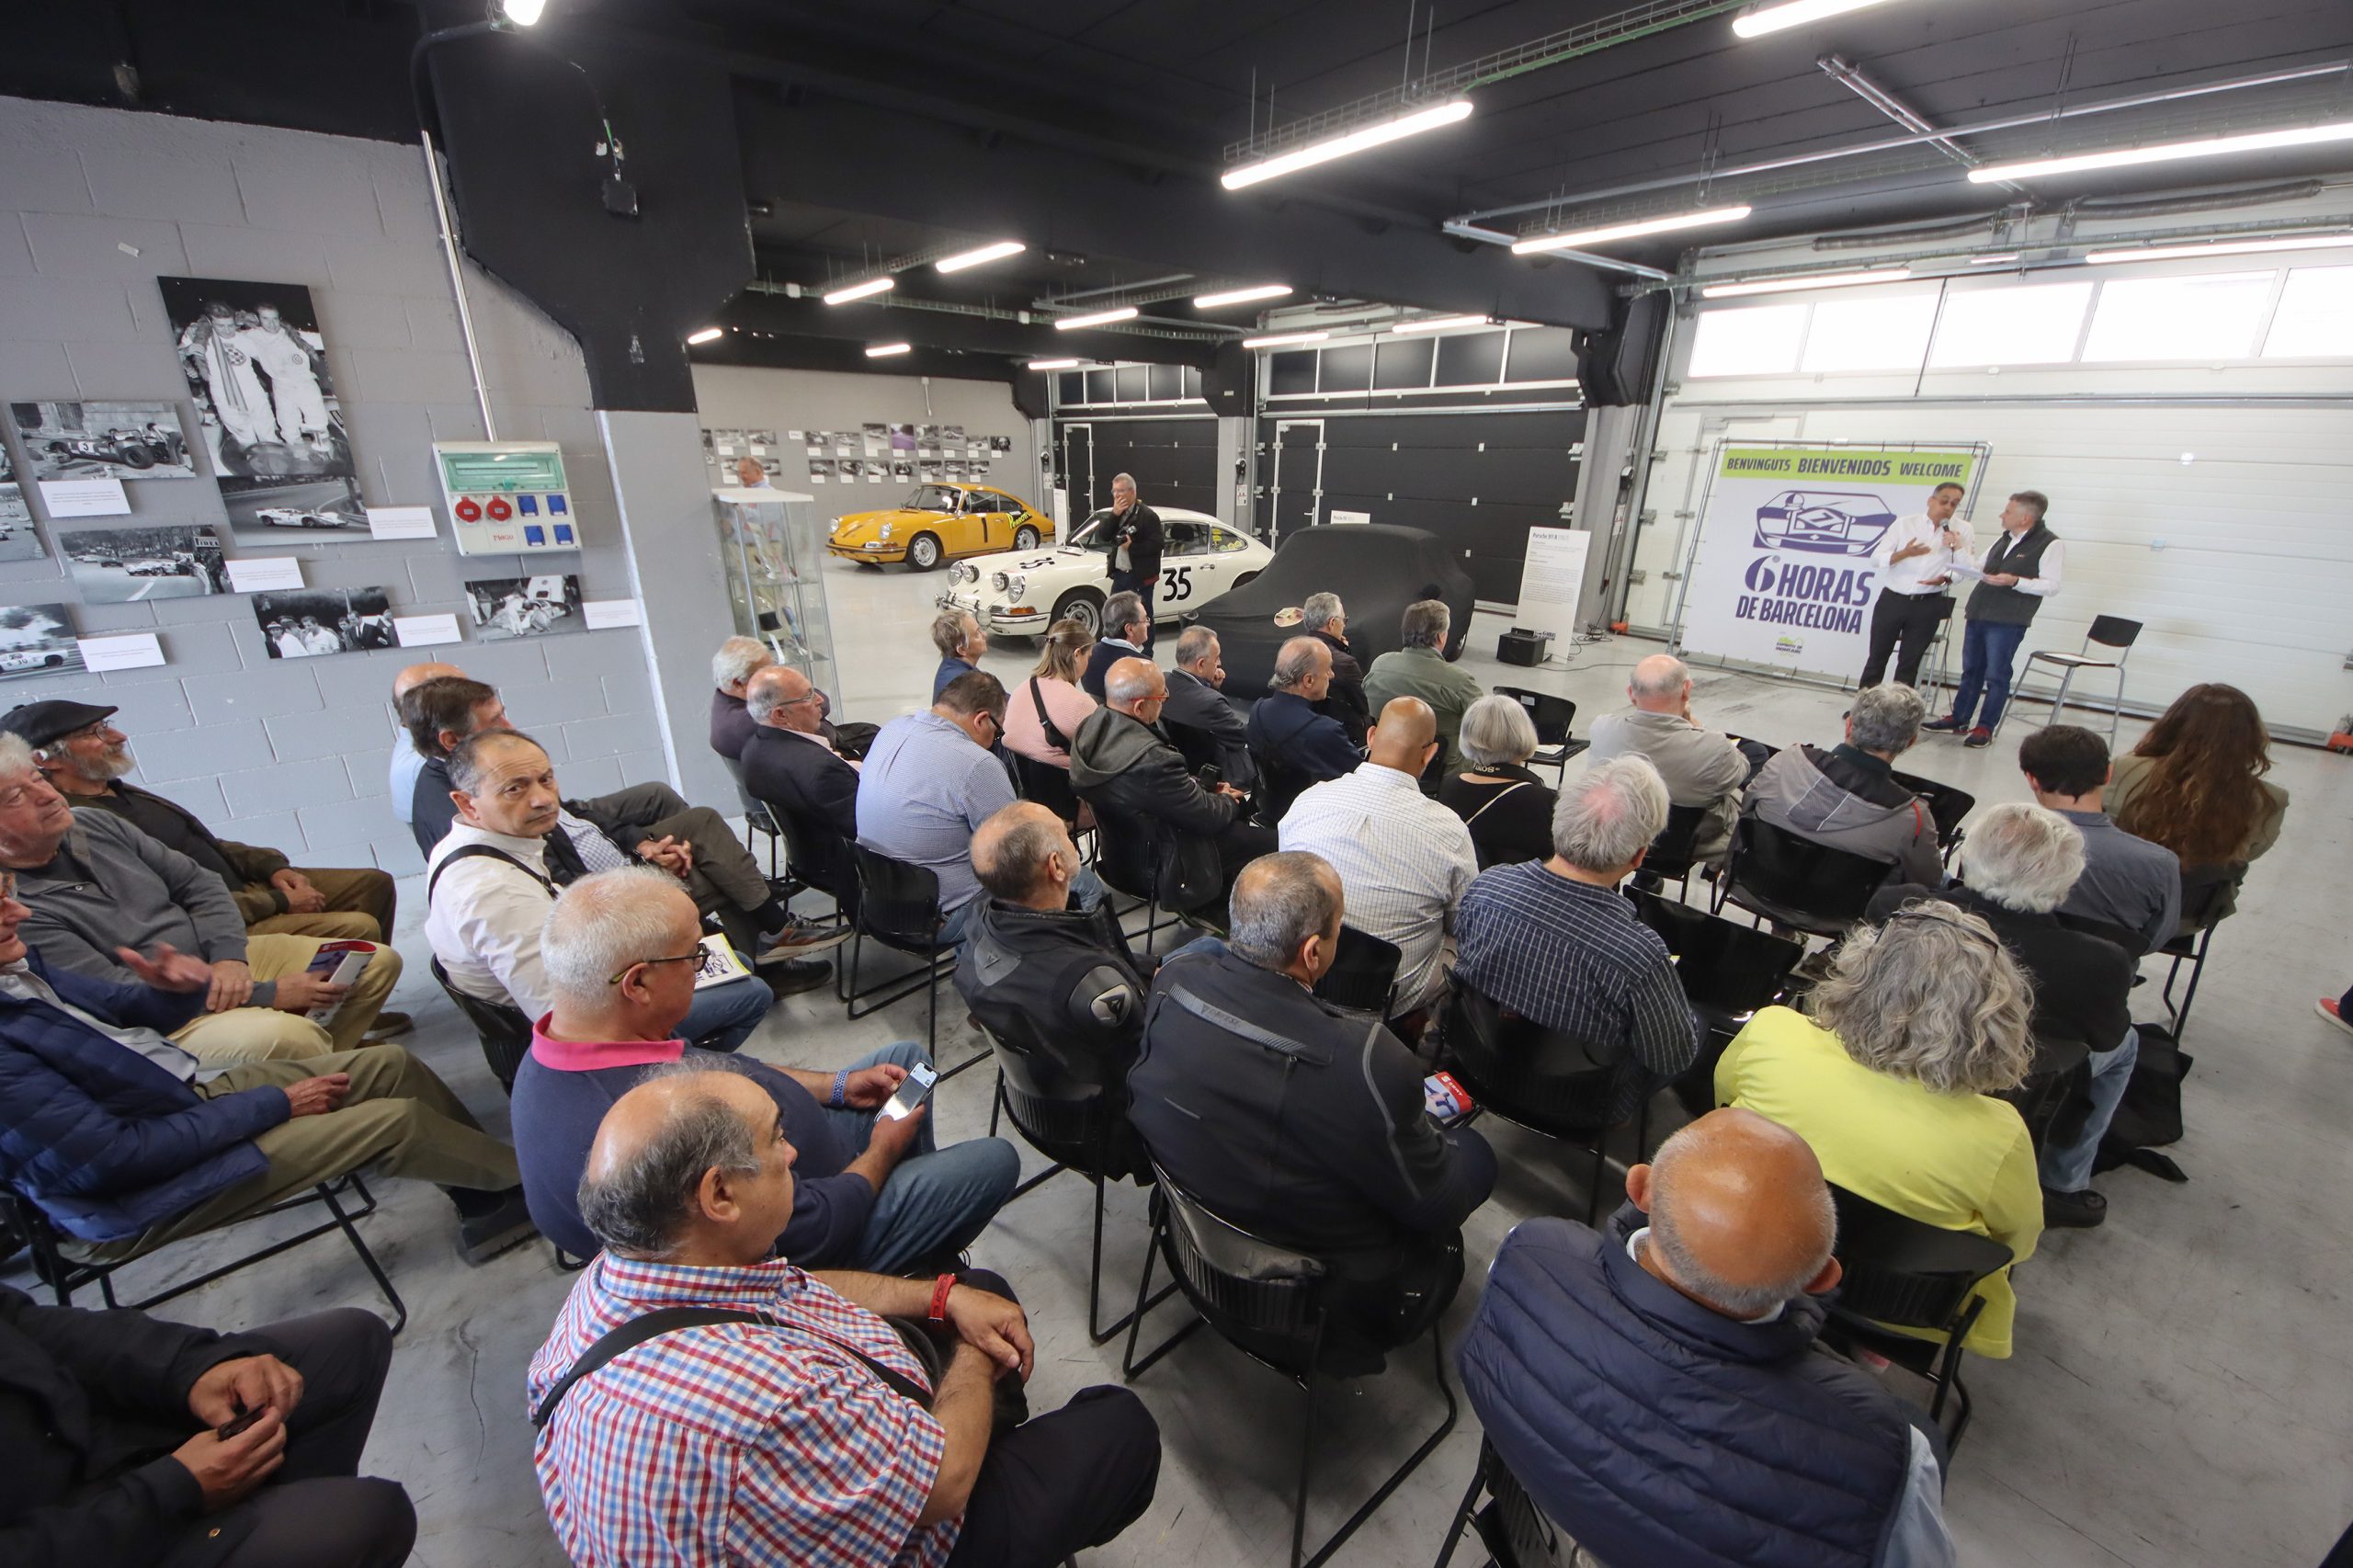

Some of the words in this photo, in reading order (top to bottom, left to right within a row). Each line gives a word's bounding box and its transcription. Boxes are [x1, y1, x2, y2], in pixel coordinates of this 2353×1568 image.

[1726, 458, 1791, 472] BENVINGUTS
[1797, 458, 1892, 476] BIENVENIDOS
[1899, 462, 1963, 478] WELCOME
[1162, 565, 1192, 602] 35
[1745, 555, 1776, 592] 6
[1776, 562, 1876, 607] HORAS
[1735, 595, 1759, 619] DE
[1758, 597, 1863, 634] BARCELONA
